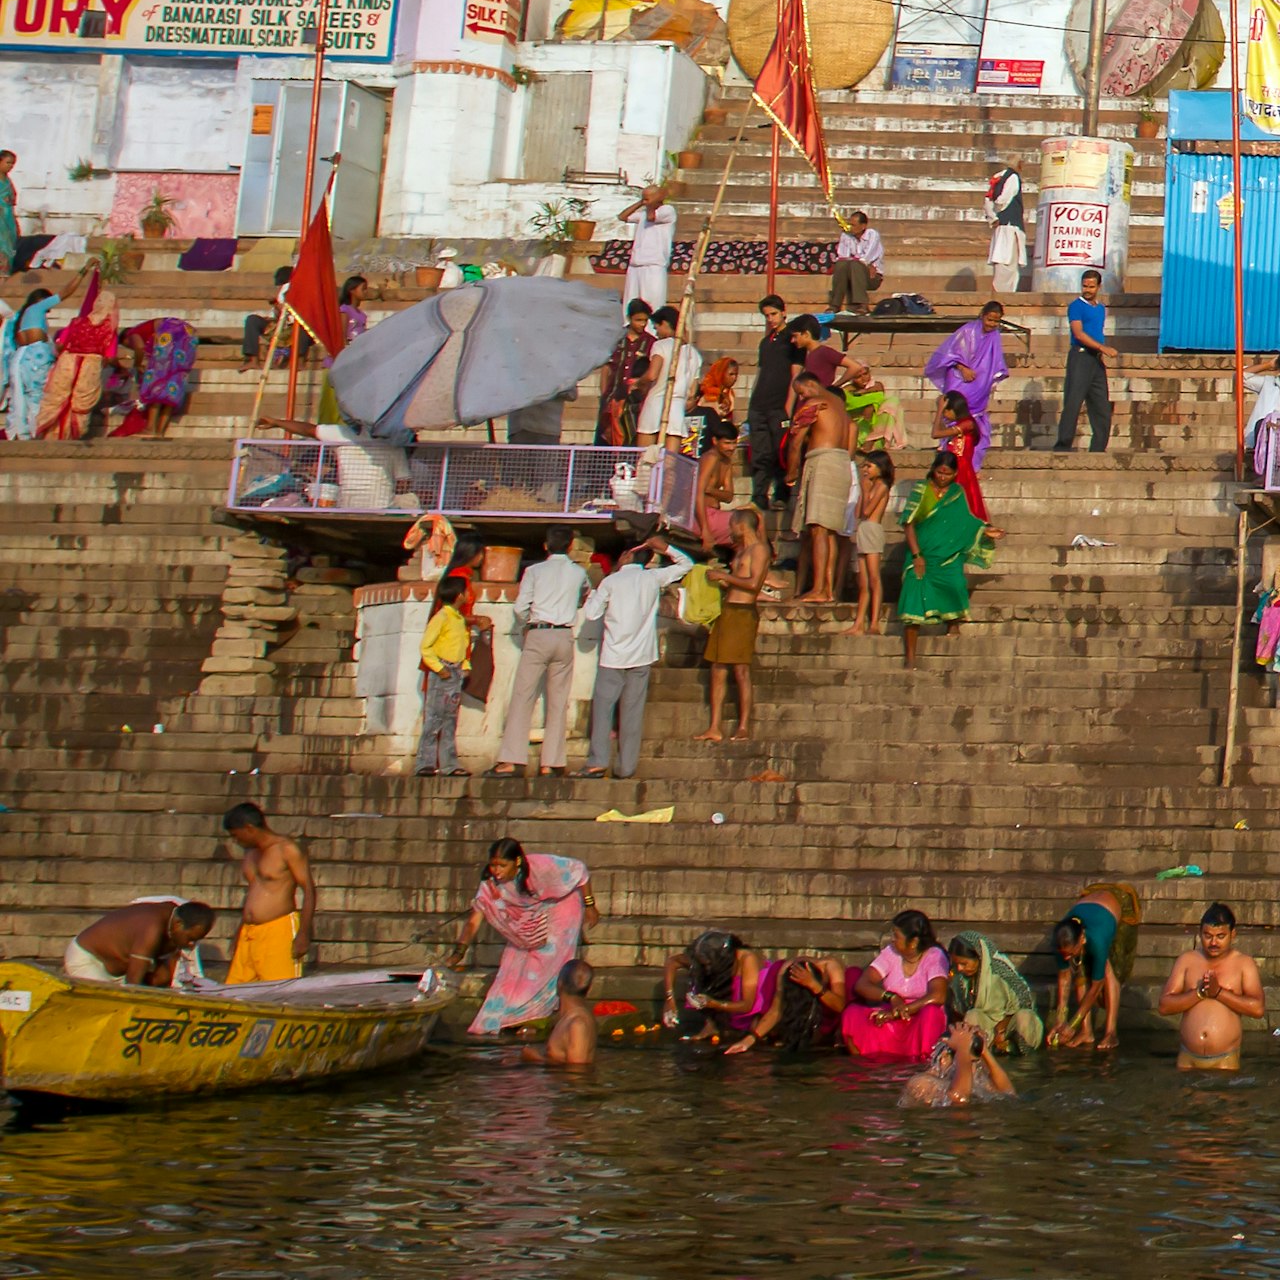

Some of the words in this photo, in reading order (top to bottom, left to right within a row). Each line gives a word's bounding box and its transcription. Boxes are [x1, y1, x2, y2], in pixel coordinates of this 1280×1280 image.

[142, 4, 160, 20] of
[162, 6, 241, 25] BANARASI
[250, 9, 292, 27] SILK
[297, 11, 362, 29] SAEES
[467, 4, 497, 25] SILK
[324, 31, 376, 49] SUITS
[1055, 207, 1103, 224] YOGA
[1053, 226, 1101, 238] TRAINING
[1055, 239, 1092, 250] CENTRE
[121, 1008, 191, 1066] यूको
[275, 1023, 318, 1049] UCO
